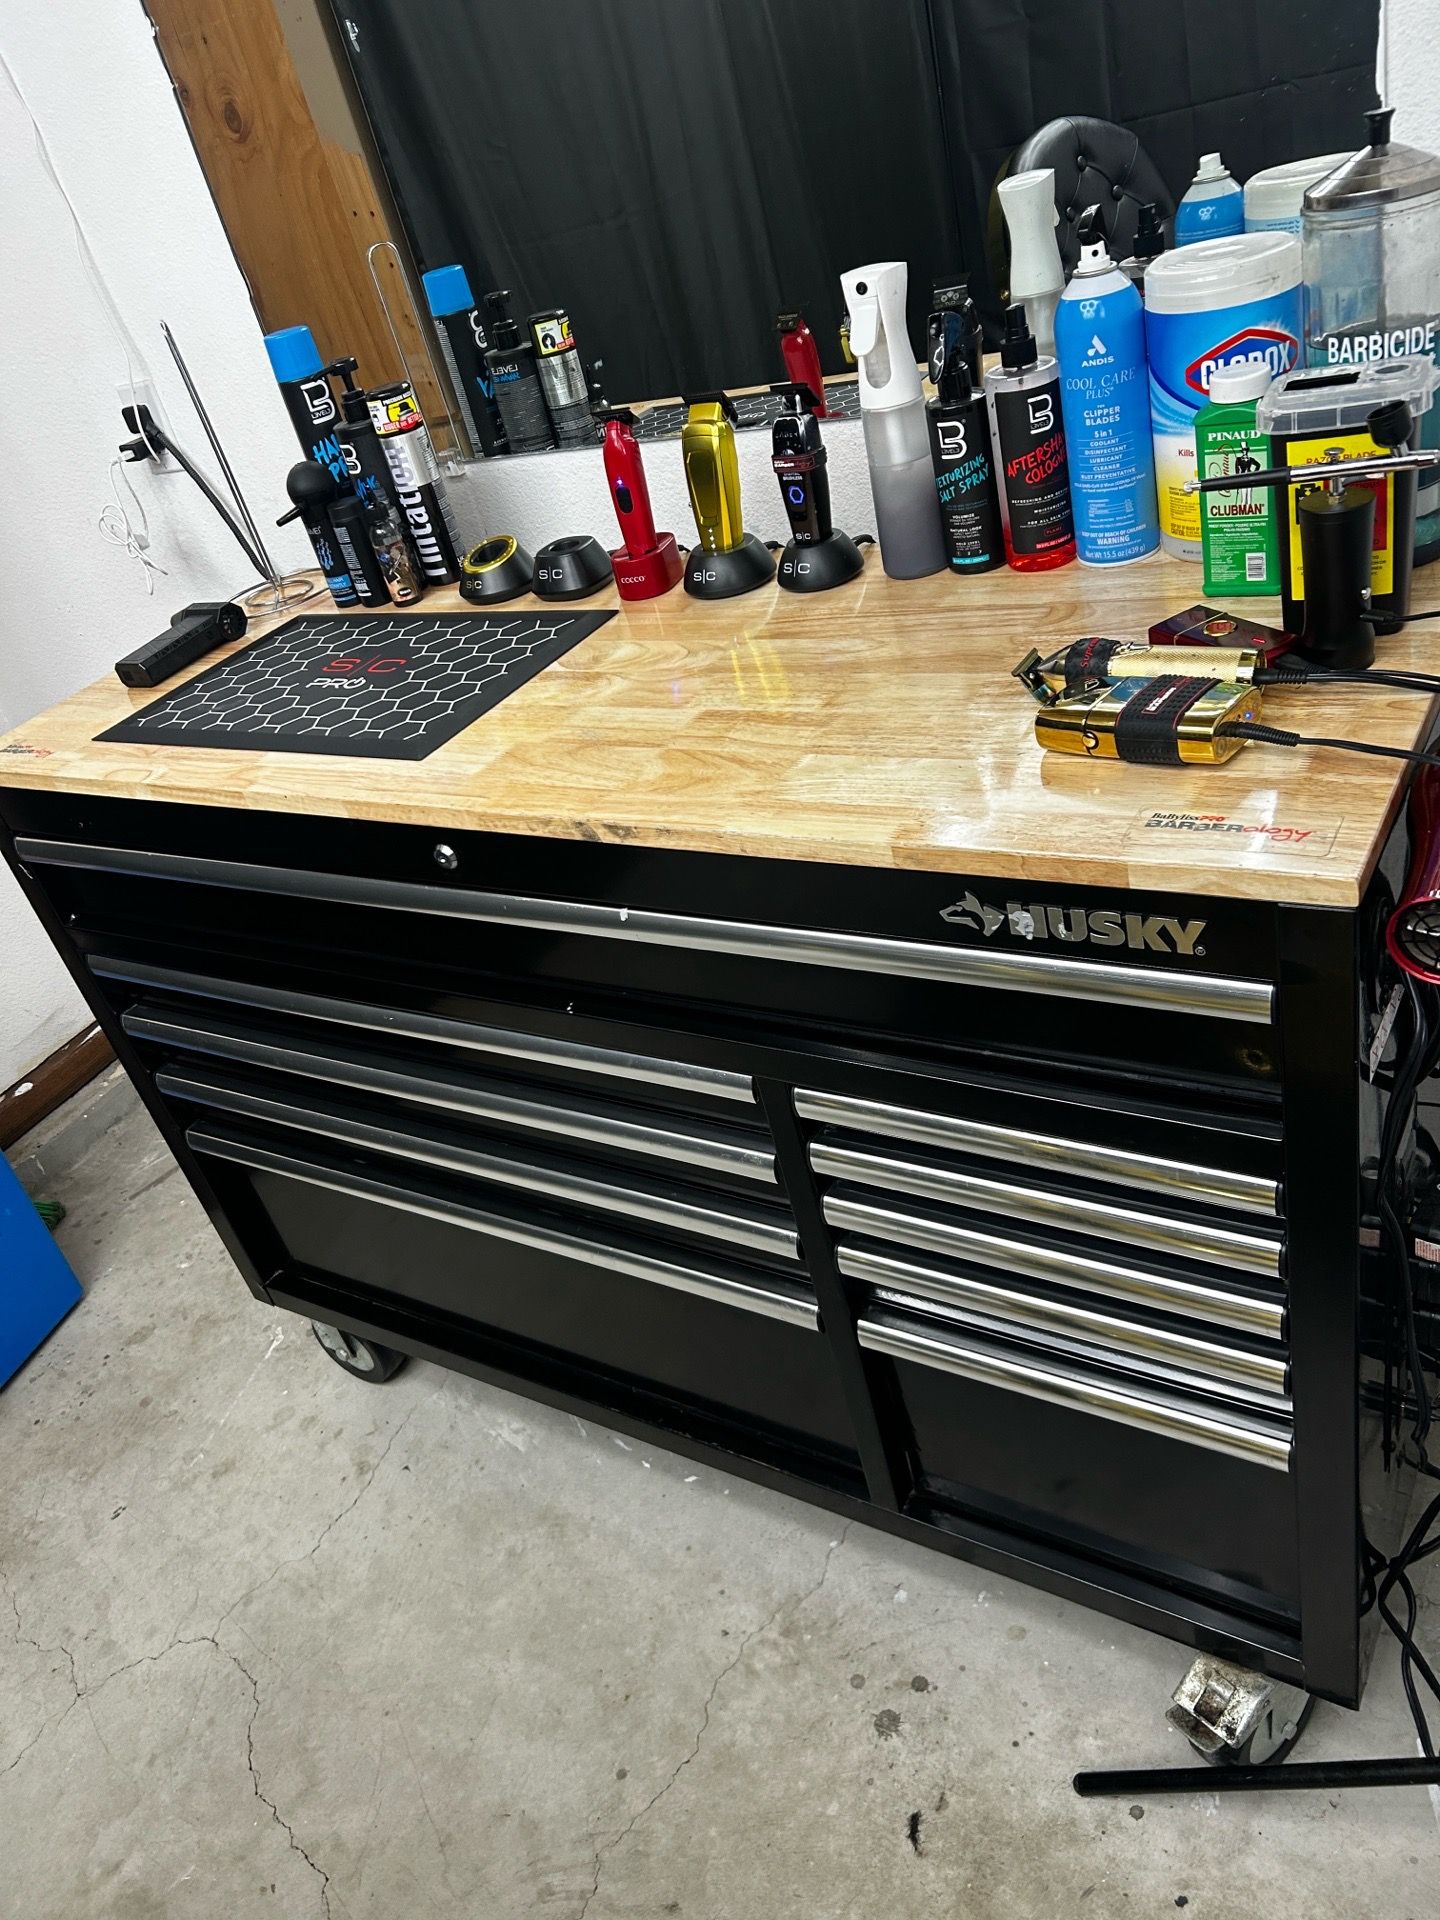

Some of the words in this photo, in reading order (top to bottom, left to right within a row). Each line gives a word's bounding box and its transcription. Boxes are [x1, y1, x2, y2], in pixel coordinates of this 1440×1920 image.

[1327, 322, 1436, 364] BARBICIDE
[1081, 356, 1115, 368] ANDIS
[1200, 340, 1291, 390] COX
[1066, 377, 1097, 390] COOL
[1101, 368, 1136, 388] CARE
[1085, 387, 1111, 400] PLUS
[1083, 405, 1121, 418] CLIPPER
[1085, 414, 1121, 426] BLADES
[1094, 430, 1100, 438] 5
[1100, 430, 1107, 438] in
[1207, 429, 1262, 442] PINAUD
[1084, 444, 1127, 455] DISINFECTANT
[1089, 438, 1120, 448] COOLANT
[1007, 431, 1065, 478] AFTERSHA
[1089, 454, 1123, 464] LUBRICANT
[1178, 449, 1195, 457] Kills
[1094, 467, 1136, 480] PREVENTATIVE
[939, 485, 956, 504] SALT
[960, 463, 990, 494] SPRAY
[1210, 504, 1263, 517] CLUBMAN
[1097, 535, 1130, 545] WARNING
[620, 575, 646, 585] COCCO
[305, 676, 367, 690] PRO
[1006, 901, 1208, 956] HUSKY
